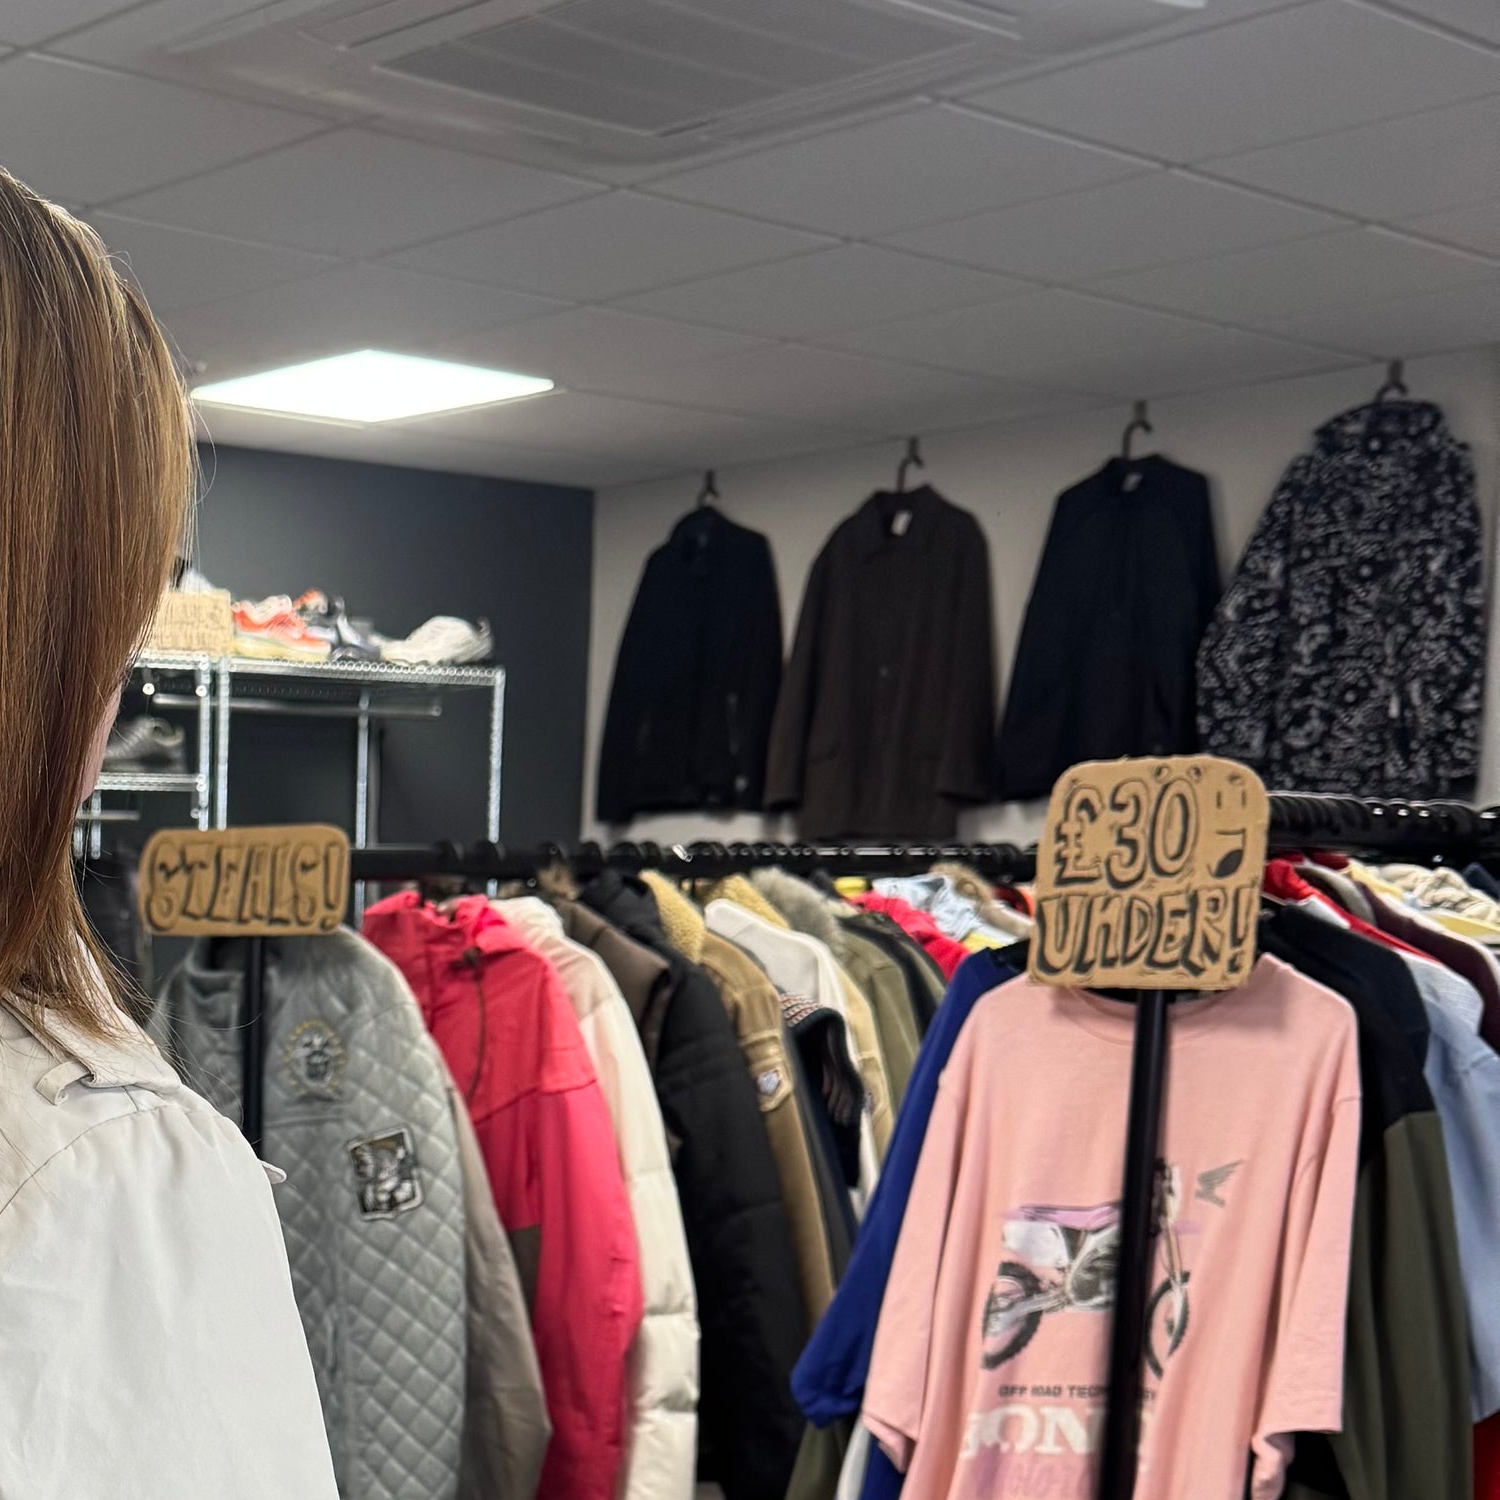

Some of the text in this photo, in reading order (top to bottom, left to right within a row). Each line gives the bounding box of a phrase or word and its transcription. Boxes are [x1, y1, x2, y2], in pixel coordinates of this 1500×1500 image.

[1055, 777, 1200, 890] £30
[145, 839, 347, 932] STEALS!
[1037, 884, 1257, 977] UNDER!
